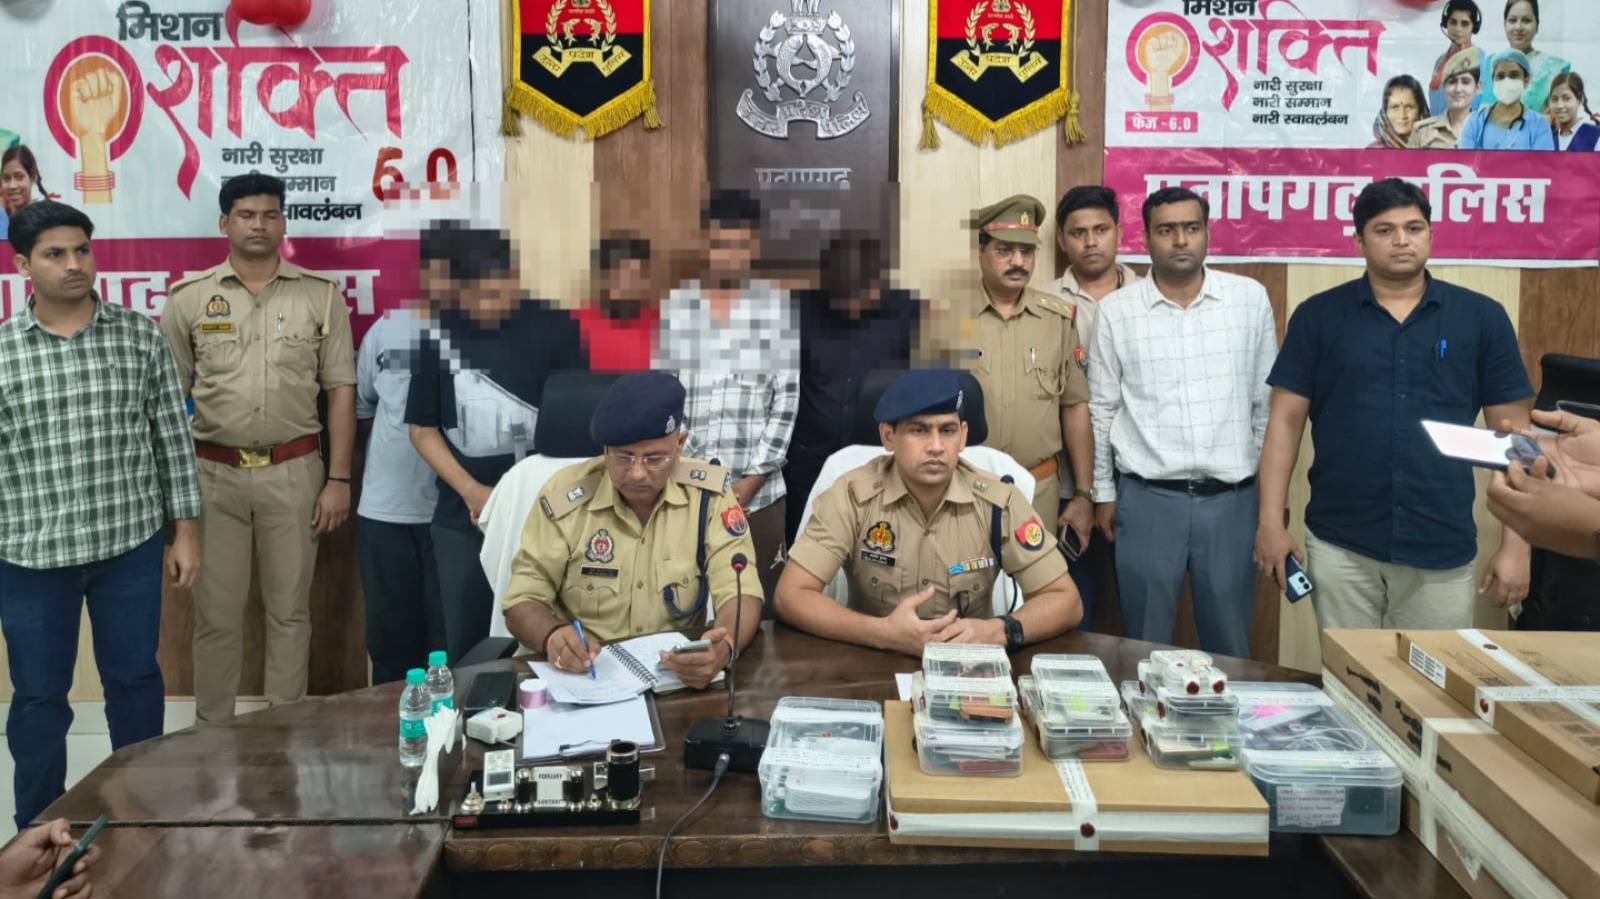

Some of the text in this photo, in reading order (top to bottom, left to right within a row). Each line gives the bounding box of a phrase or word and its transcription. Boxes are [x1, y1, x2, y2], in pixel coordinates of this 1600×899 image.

[116, 1, 224, 41] मिशन
[1202, 0, 1387, 112] शक्ति
[1253, 76, 1322, 96] नारी सुरक्षा
[146, 4, 409, 201] शक्ति
[1252, 94, 1332, 108] नारी सम्मान
[1169, 117, 1191, 130] 6.0
[1252, 110, 1349, 125] नारी स्वावलंबन
[222, 142, 324, 172] नारी सुरक्षा
[284, 176, 337, 192] म्मान
[1384, 163, 1551, 223] लिस
